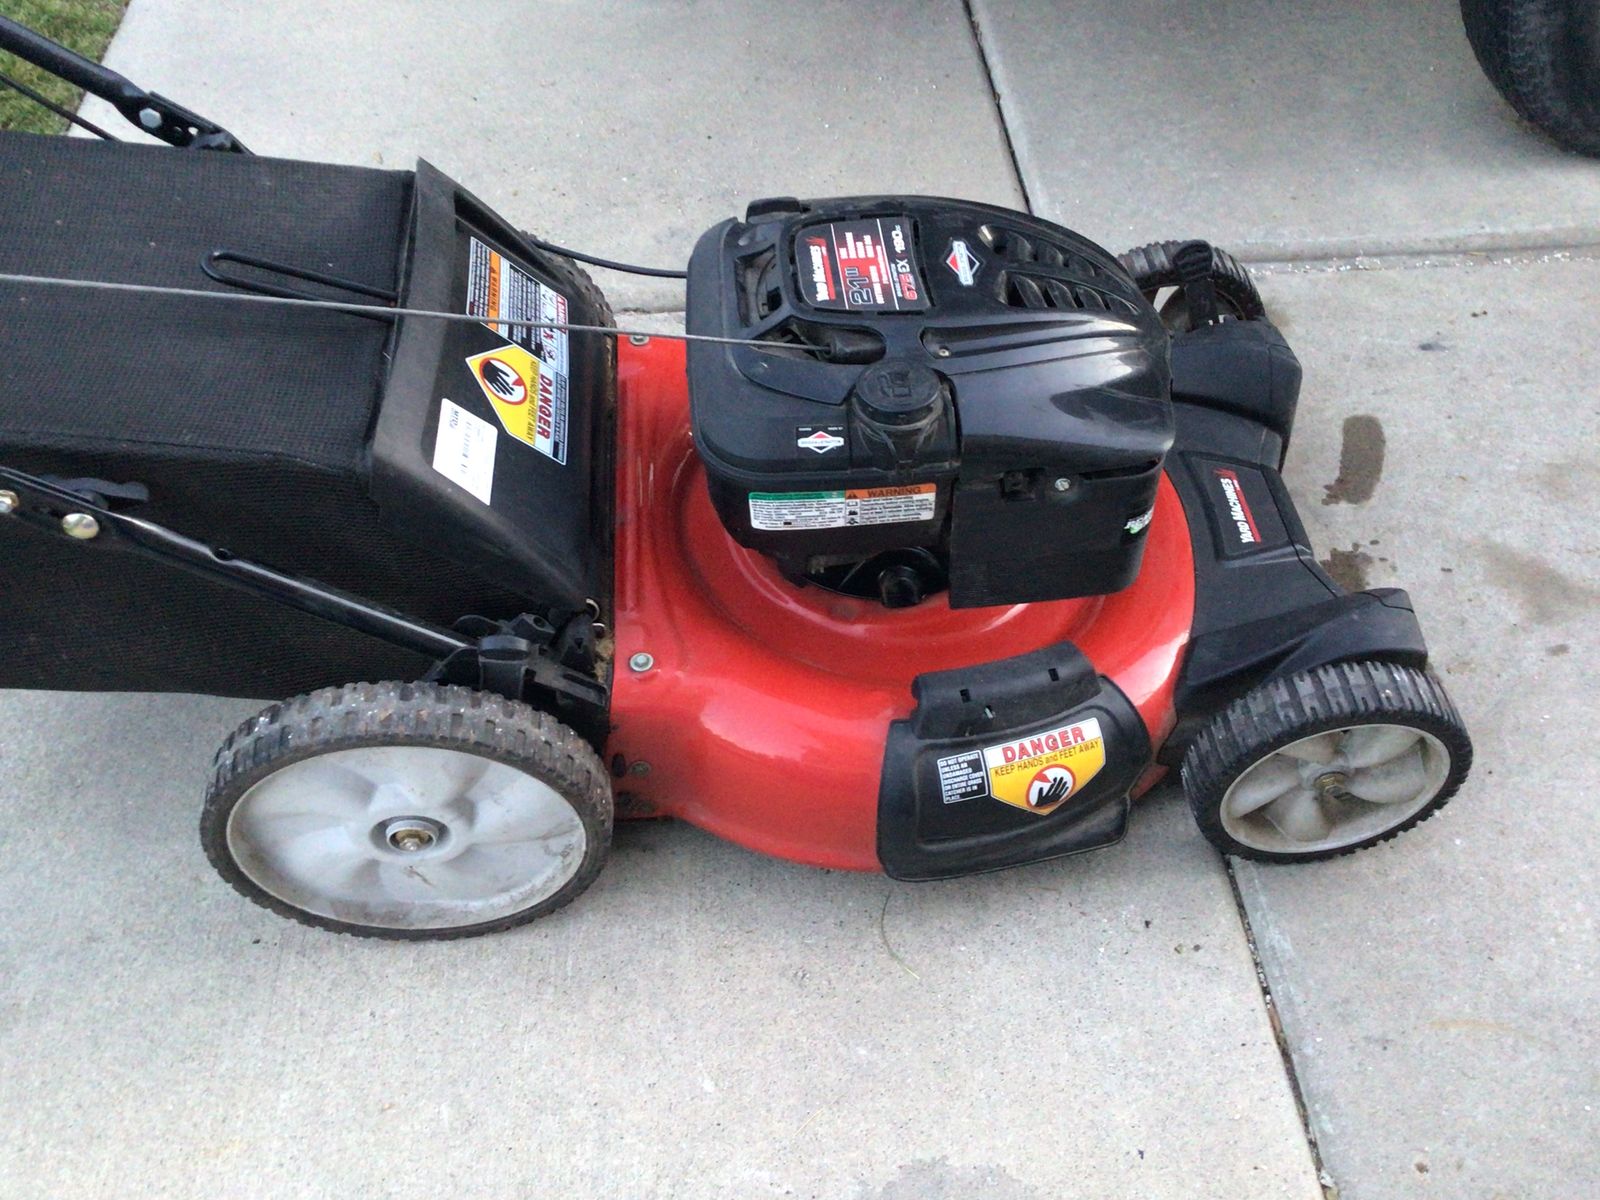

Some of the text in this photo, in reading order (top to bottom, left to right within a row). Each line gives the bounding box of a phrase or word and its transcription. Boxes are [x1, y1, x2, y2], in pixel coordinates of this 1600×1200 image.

[490, 273, 498, 312] WARNING
[537, 373, 553, 440] DANGER
[526, 421, 535, 441] AWAY
[867, 486, 922, 498] WARNING
[1220, 478, 1255, 543] YARD MACHINES
[994, 741, 1099, 777] KEEP HANDS and FEET AWAY
[1002, 726, 1086, 763] DANGER
